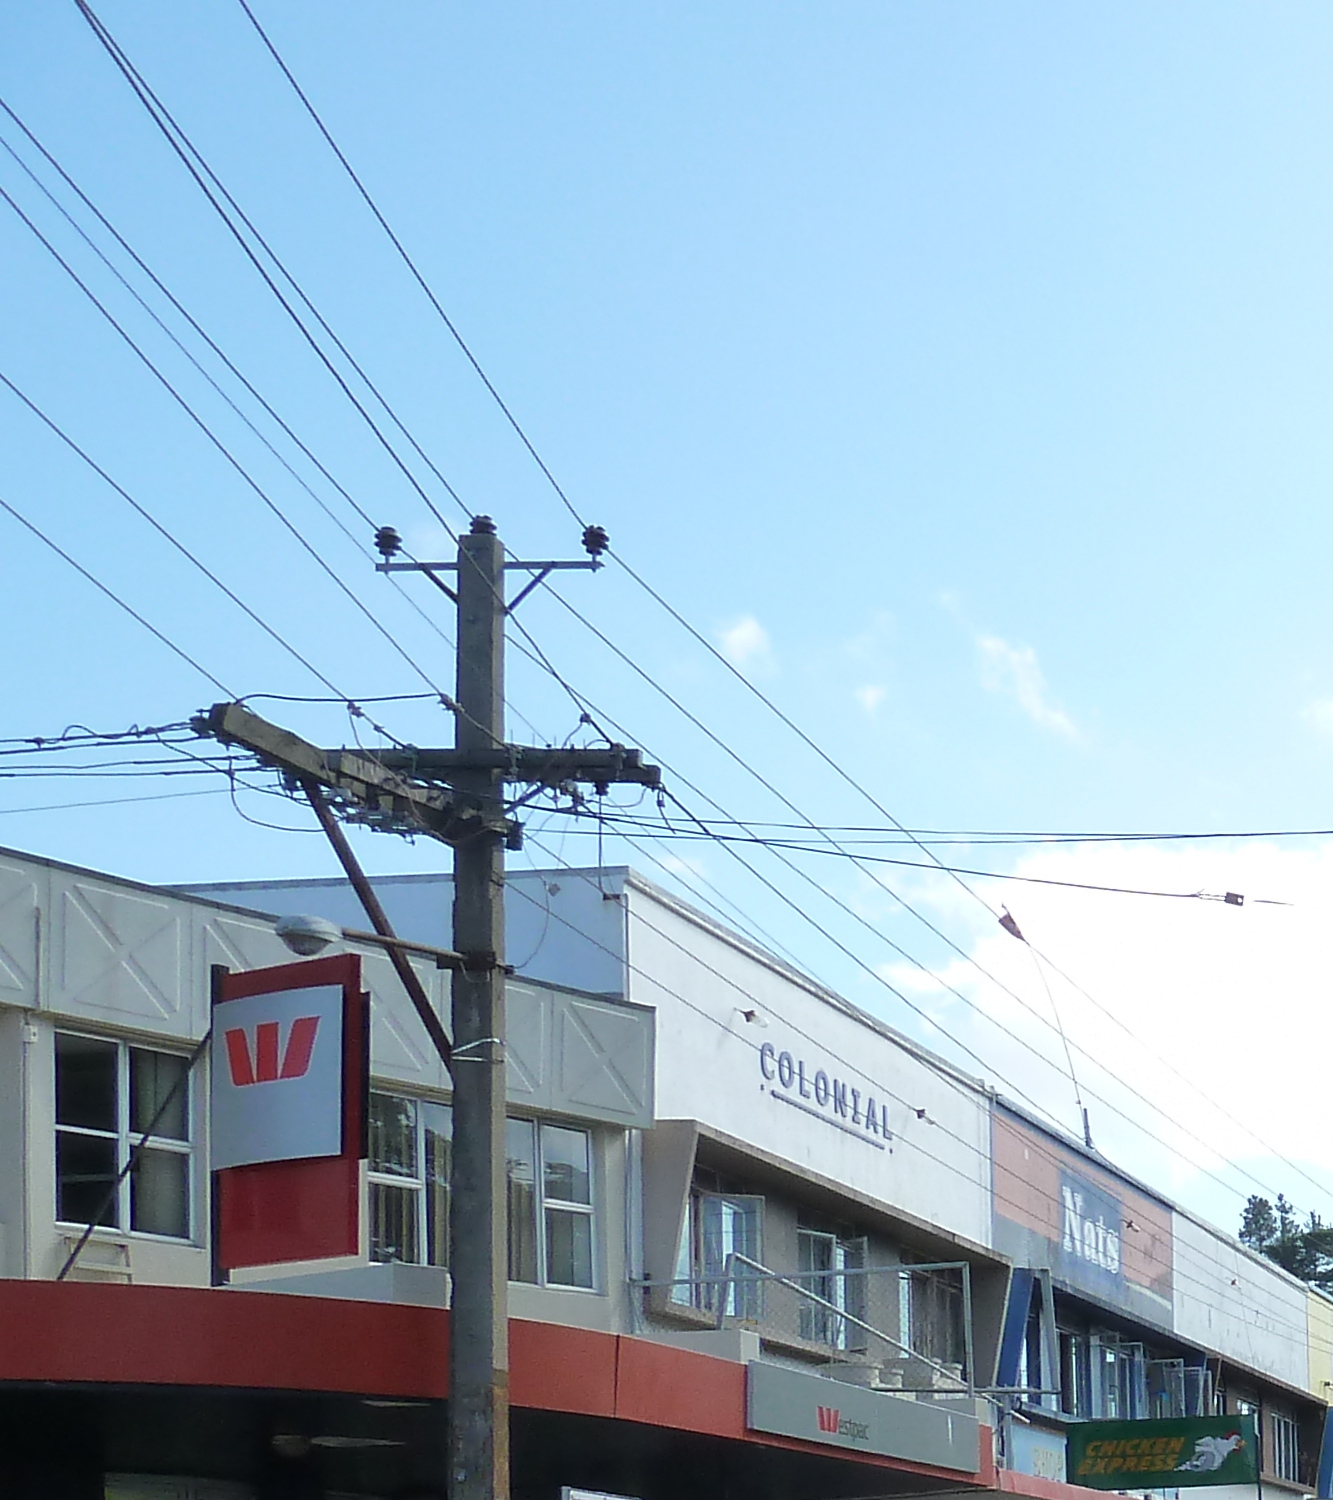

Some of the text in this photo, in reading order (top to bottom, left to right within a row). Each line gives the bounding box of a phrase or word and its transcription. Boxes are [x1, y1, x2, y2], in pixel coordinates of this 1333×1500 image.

[760, 1041, 893, 1141] COLONIAL
[817, 1405, 869, 1441] Westpac
[1085, 1437, 1186, 1457] CHICKEN
[1077, 1454, 1180, 1475] EXPRESS
